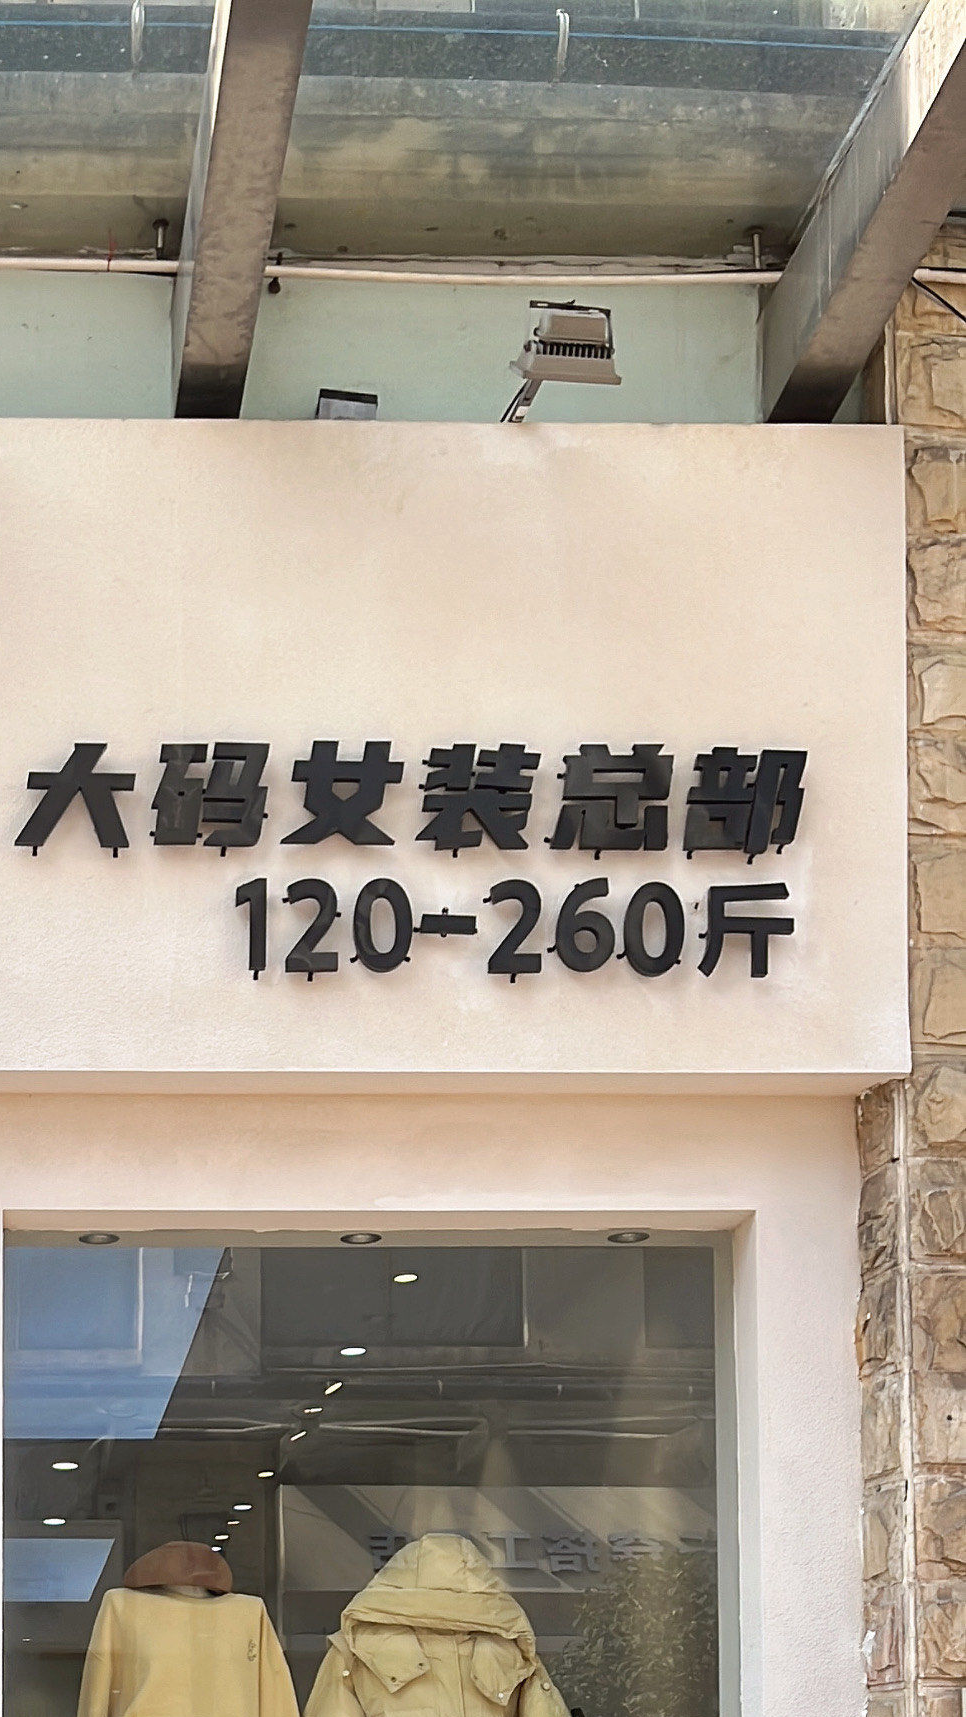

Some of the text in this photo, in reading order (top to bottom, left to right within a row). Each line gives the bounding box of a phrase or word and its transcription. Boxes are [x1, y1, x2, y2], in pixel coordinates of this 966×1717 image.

[14, 740, 808, 860] 大码女装总部
[234, 876, 796, 980] 120-260斤
